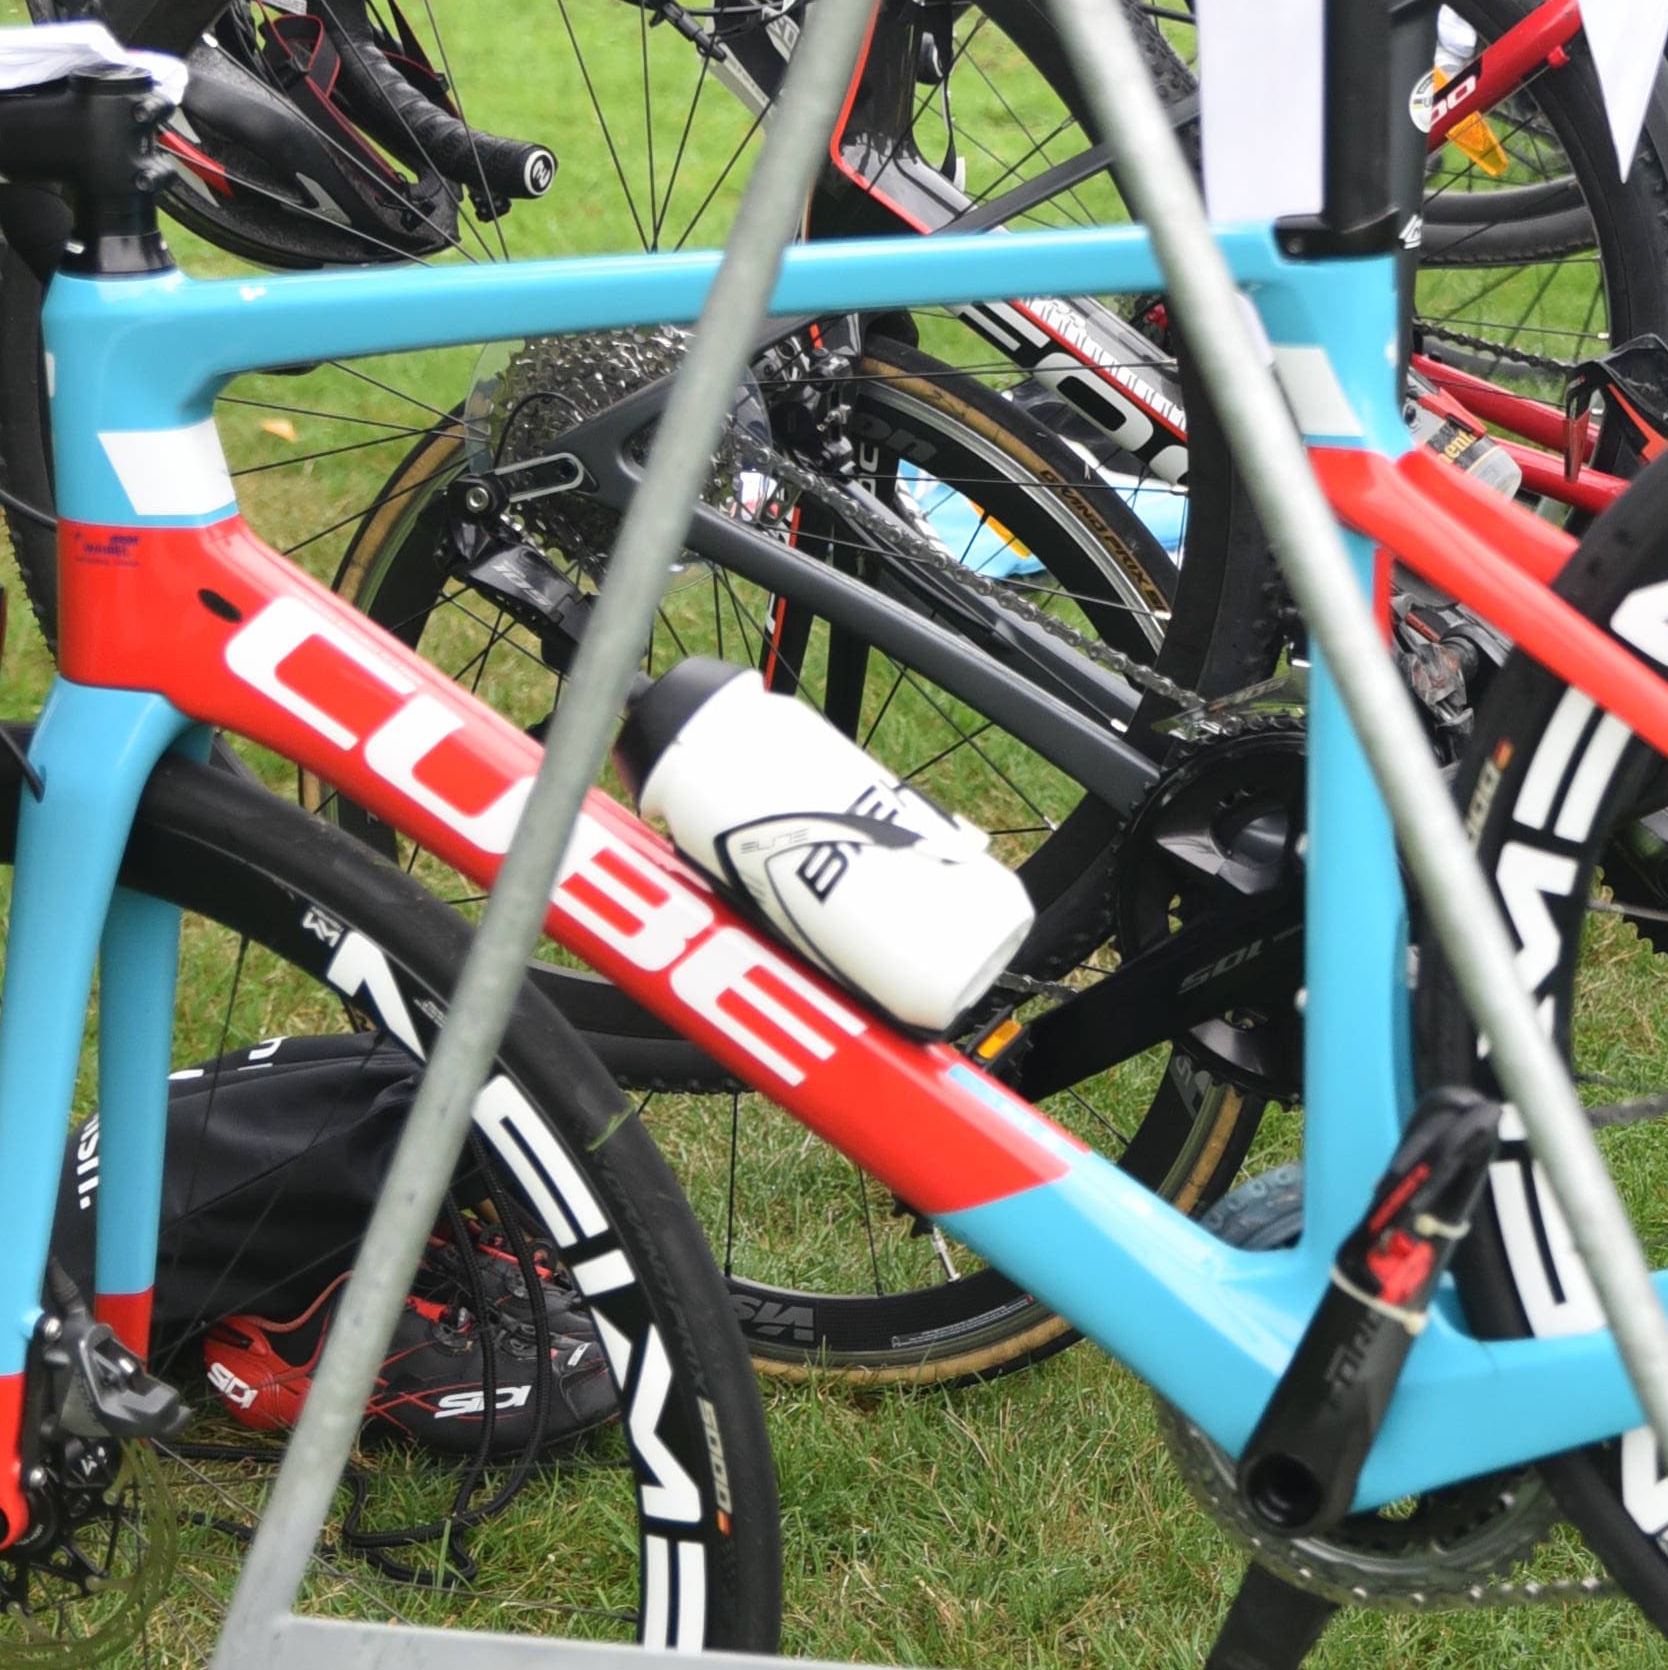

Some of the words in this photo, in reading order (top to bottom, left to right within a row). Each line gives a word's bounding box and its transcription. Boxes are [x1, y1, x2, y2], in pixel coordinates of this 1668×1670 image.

[224, 594, 870, 1087] CUBE
[206, 1362, 258, 1409] SIDI
[696, 1394, 733, 1515] 5000
